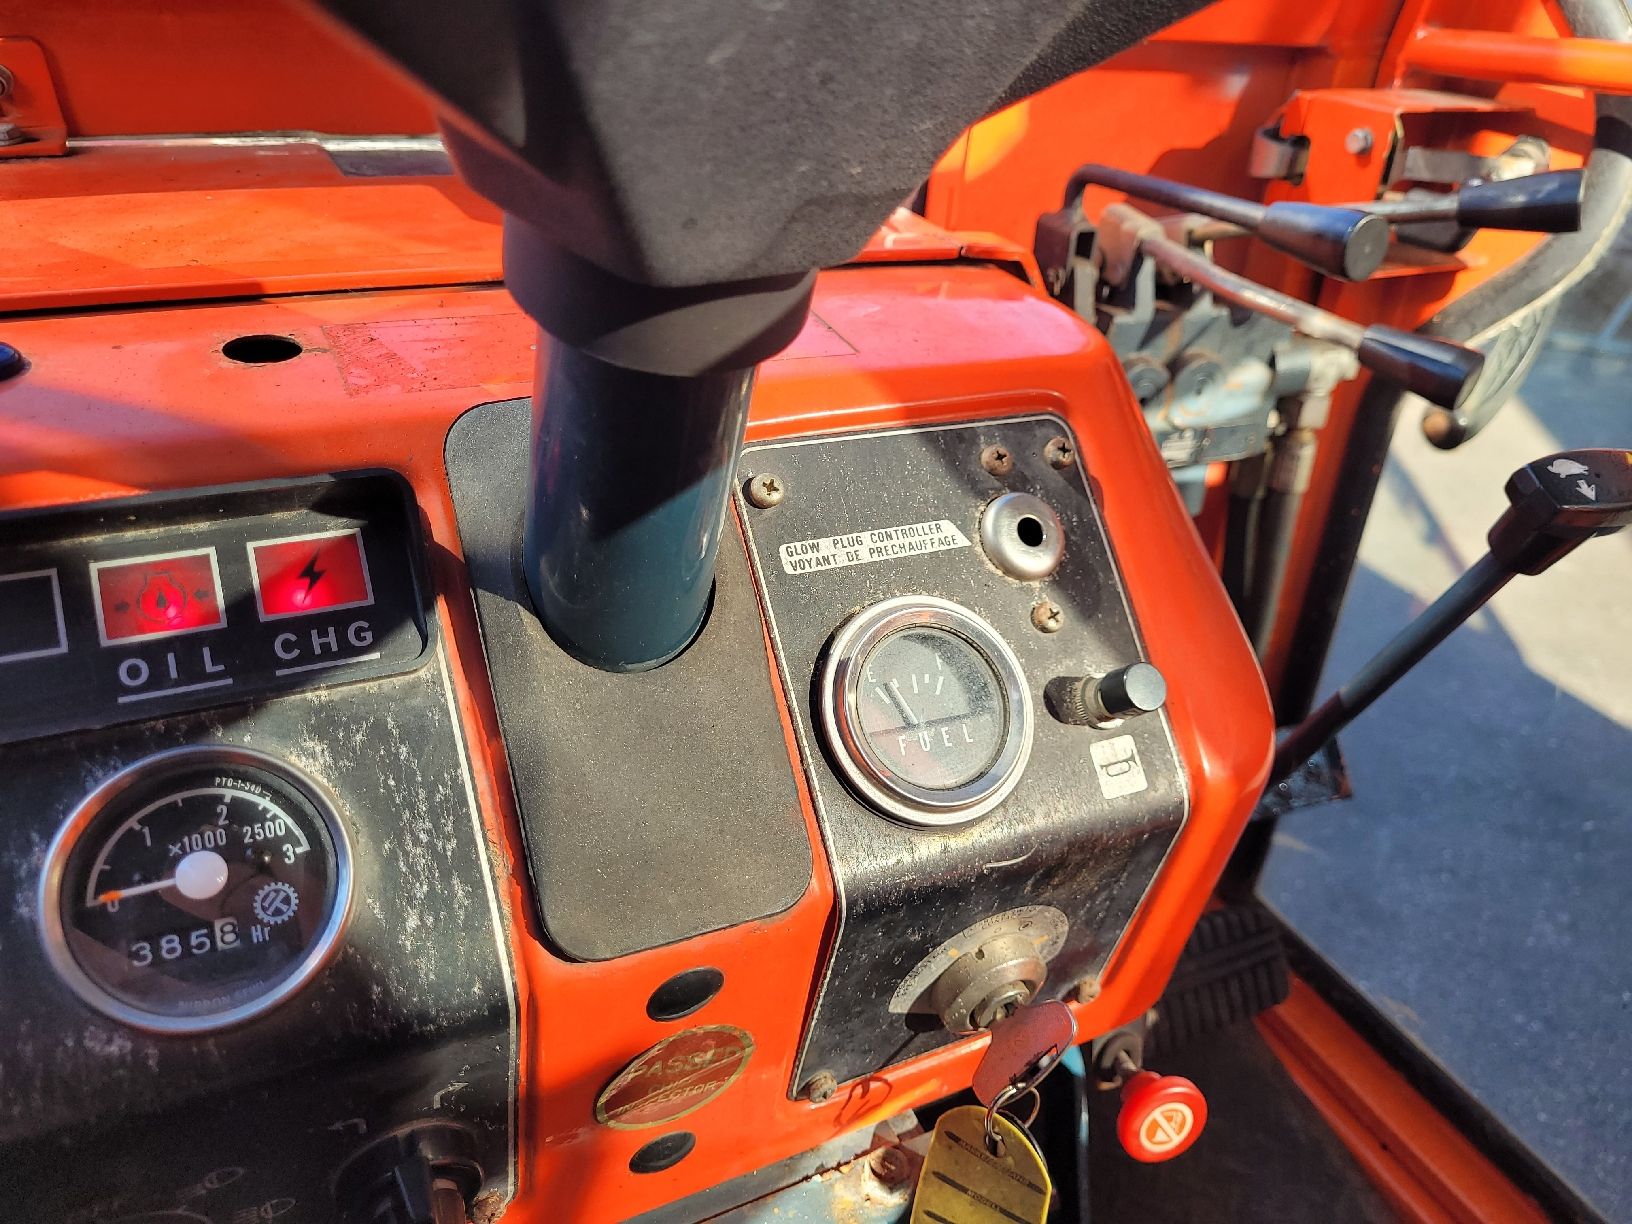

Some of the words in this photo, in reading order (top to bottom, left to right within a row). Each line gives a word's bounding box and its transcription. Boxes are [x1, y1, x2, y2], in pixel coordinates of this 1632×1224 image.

[784, 541, 821, 558] GLOW
[832, 535, 864, 550] PLUG
[869, 523, 944, 544] CONTROLLER
[788, 554, 838, 573] VOYANT
[846, 550, 862, 562] DE
[868, 534, 959, 559] PRECHAUFFAGE
[273, 620, 375, 660] CHG
[118, 646, 226, 687] OIL
[897, 723, 974, 757] FUEL
[216, 804, 230, 826] 2
[141, 825, 153, 848] 1
[242, 818, 287, 844] 2500
[282, 843, 296, 865] 3
[251, 924, 271, 945] Hr
